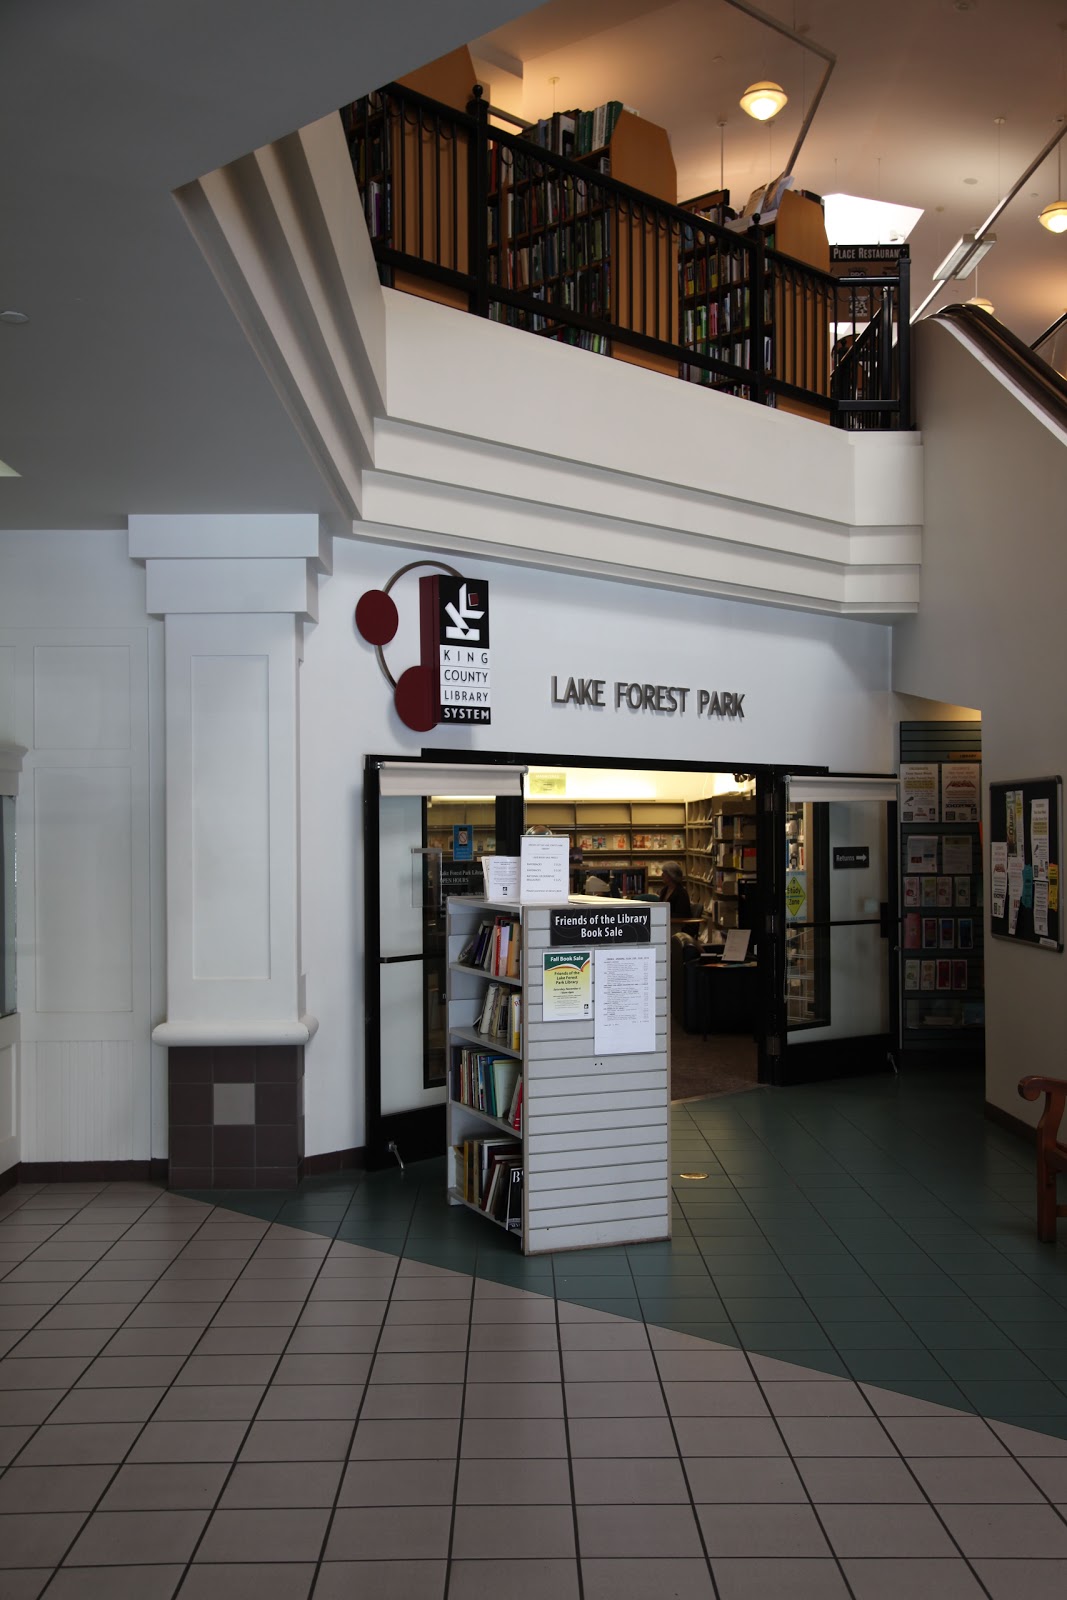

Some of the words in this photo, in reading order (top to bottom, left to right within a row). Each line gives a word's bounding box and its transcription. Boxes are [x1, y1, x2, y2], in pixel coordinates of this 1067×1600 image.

[858, 247, 901, 259] RESTAURAN
[444, 649, 489, 664] KING
[444, 669, 489, 683] COUNTY
[444, 690, 489, 702] LIBRARY
[550, 675, 606, 707] LAKE
[614, 681, 690, 713] FOREST
[696, 689, 745, 718] PARK
[443, 707, 490, 720] SYSTEM
[555, 914, 587, 926] Friends
[589, 914, 599, 925] of
[600, 914, 615, 924] the
[617, 913, 648, 925] Library
[581, 927, 603, 938] Book
[604, 926, 623, 937] Sale
